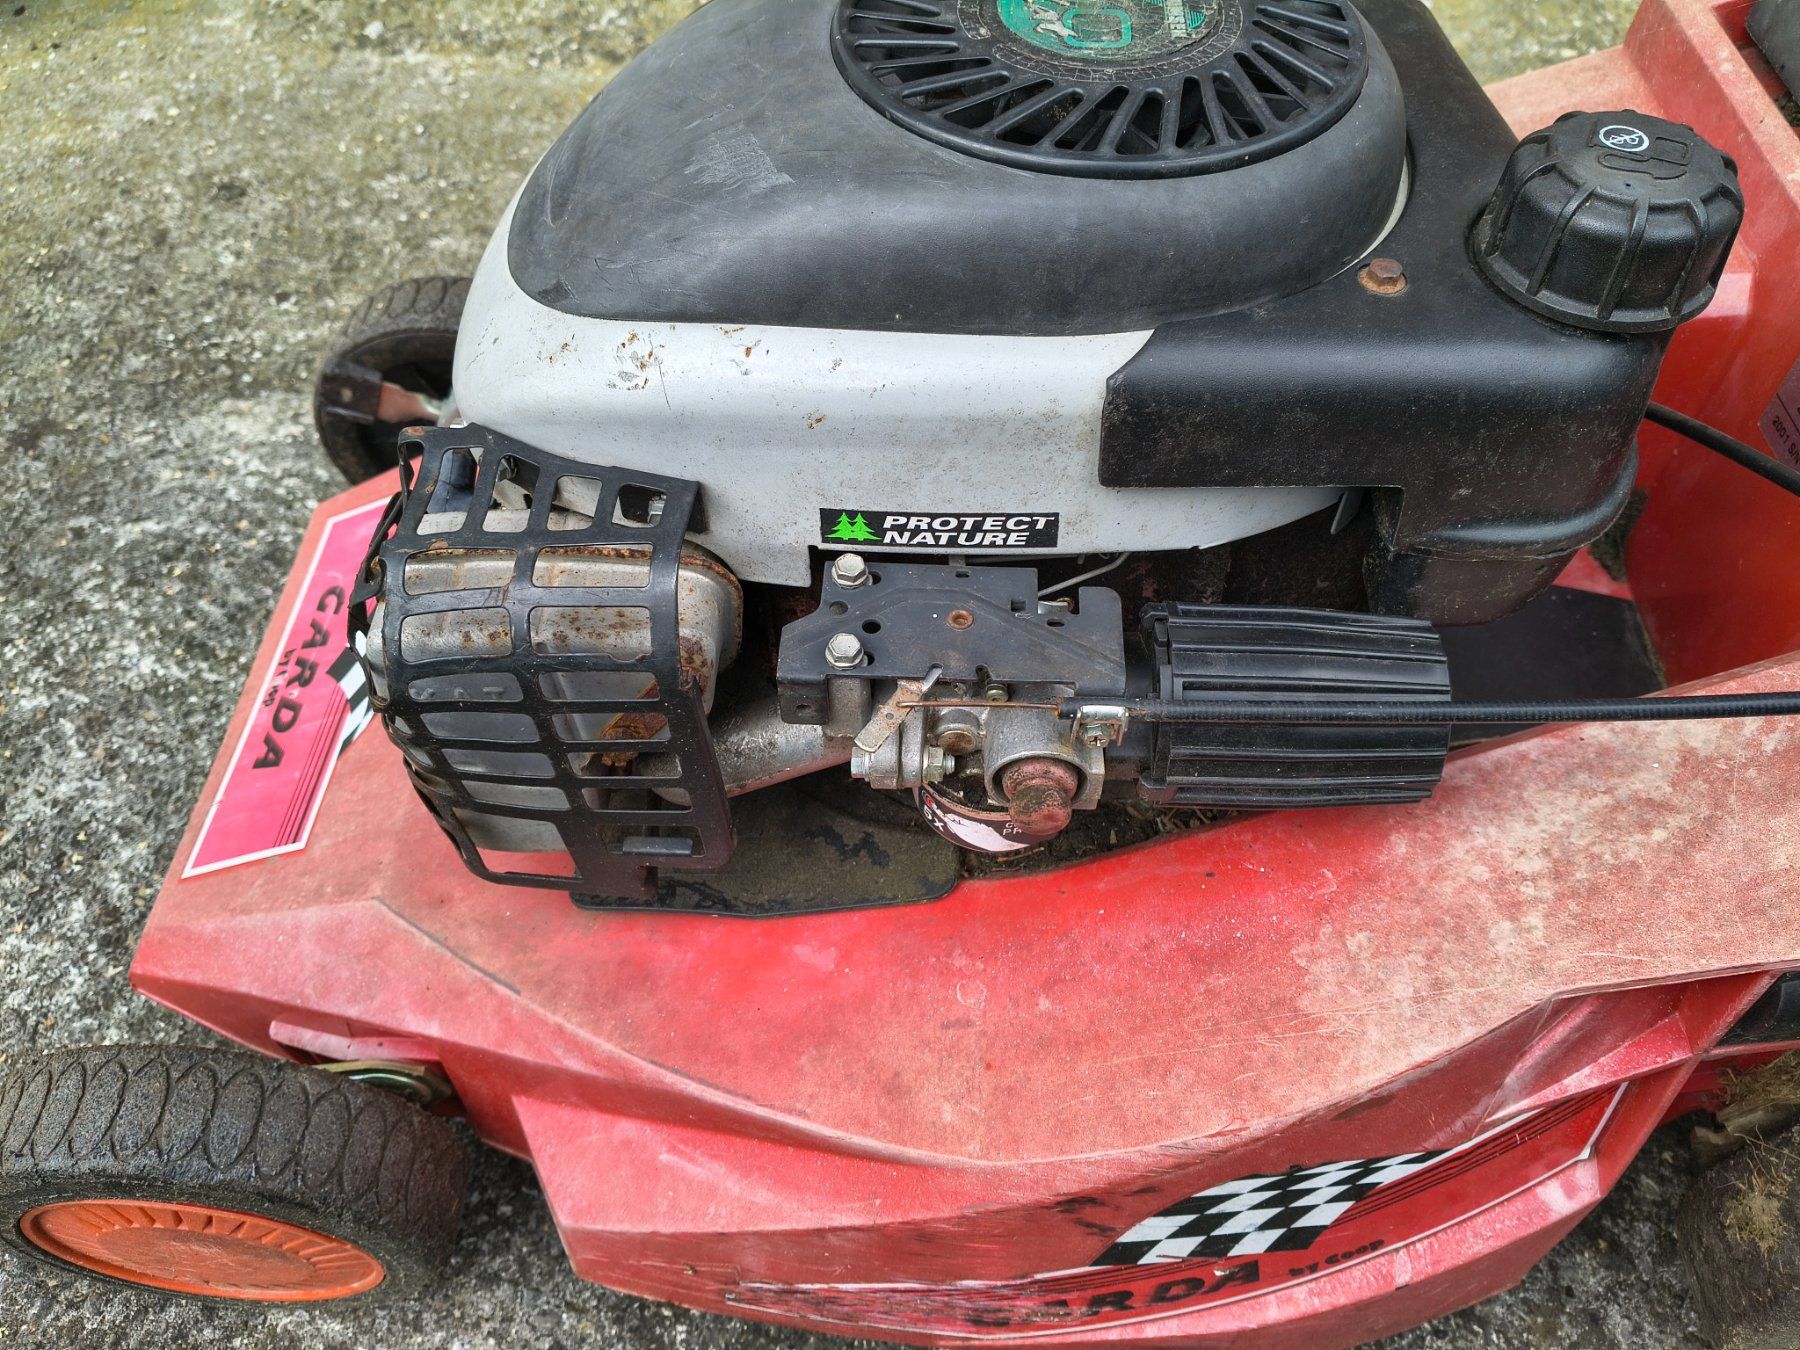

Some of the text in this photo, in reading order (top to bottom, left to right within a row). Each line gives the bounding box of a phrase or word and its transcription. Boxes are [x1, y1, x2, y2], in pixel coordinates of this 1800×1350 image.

[882, 515, 1055, 531] PROTECT
[882, 531, 1030, 546] NATURE
[252, 585, 346, 770] CARDA
[1288, 1262, 1319, 1277] by
[1325, 1239, 1385, 1265] Coop
